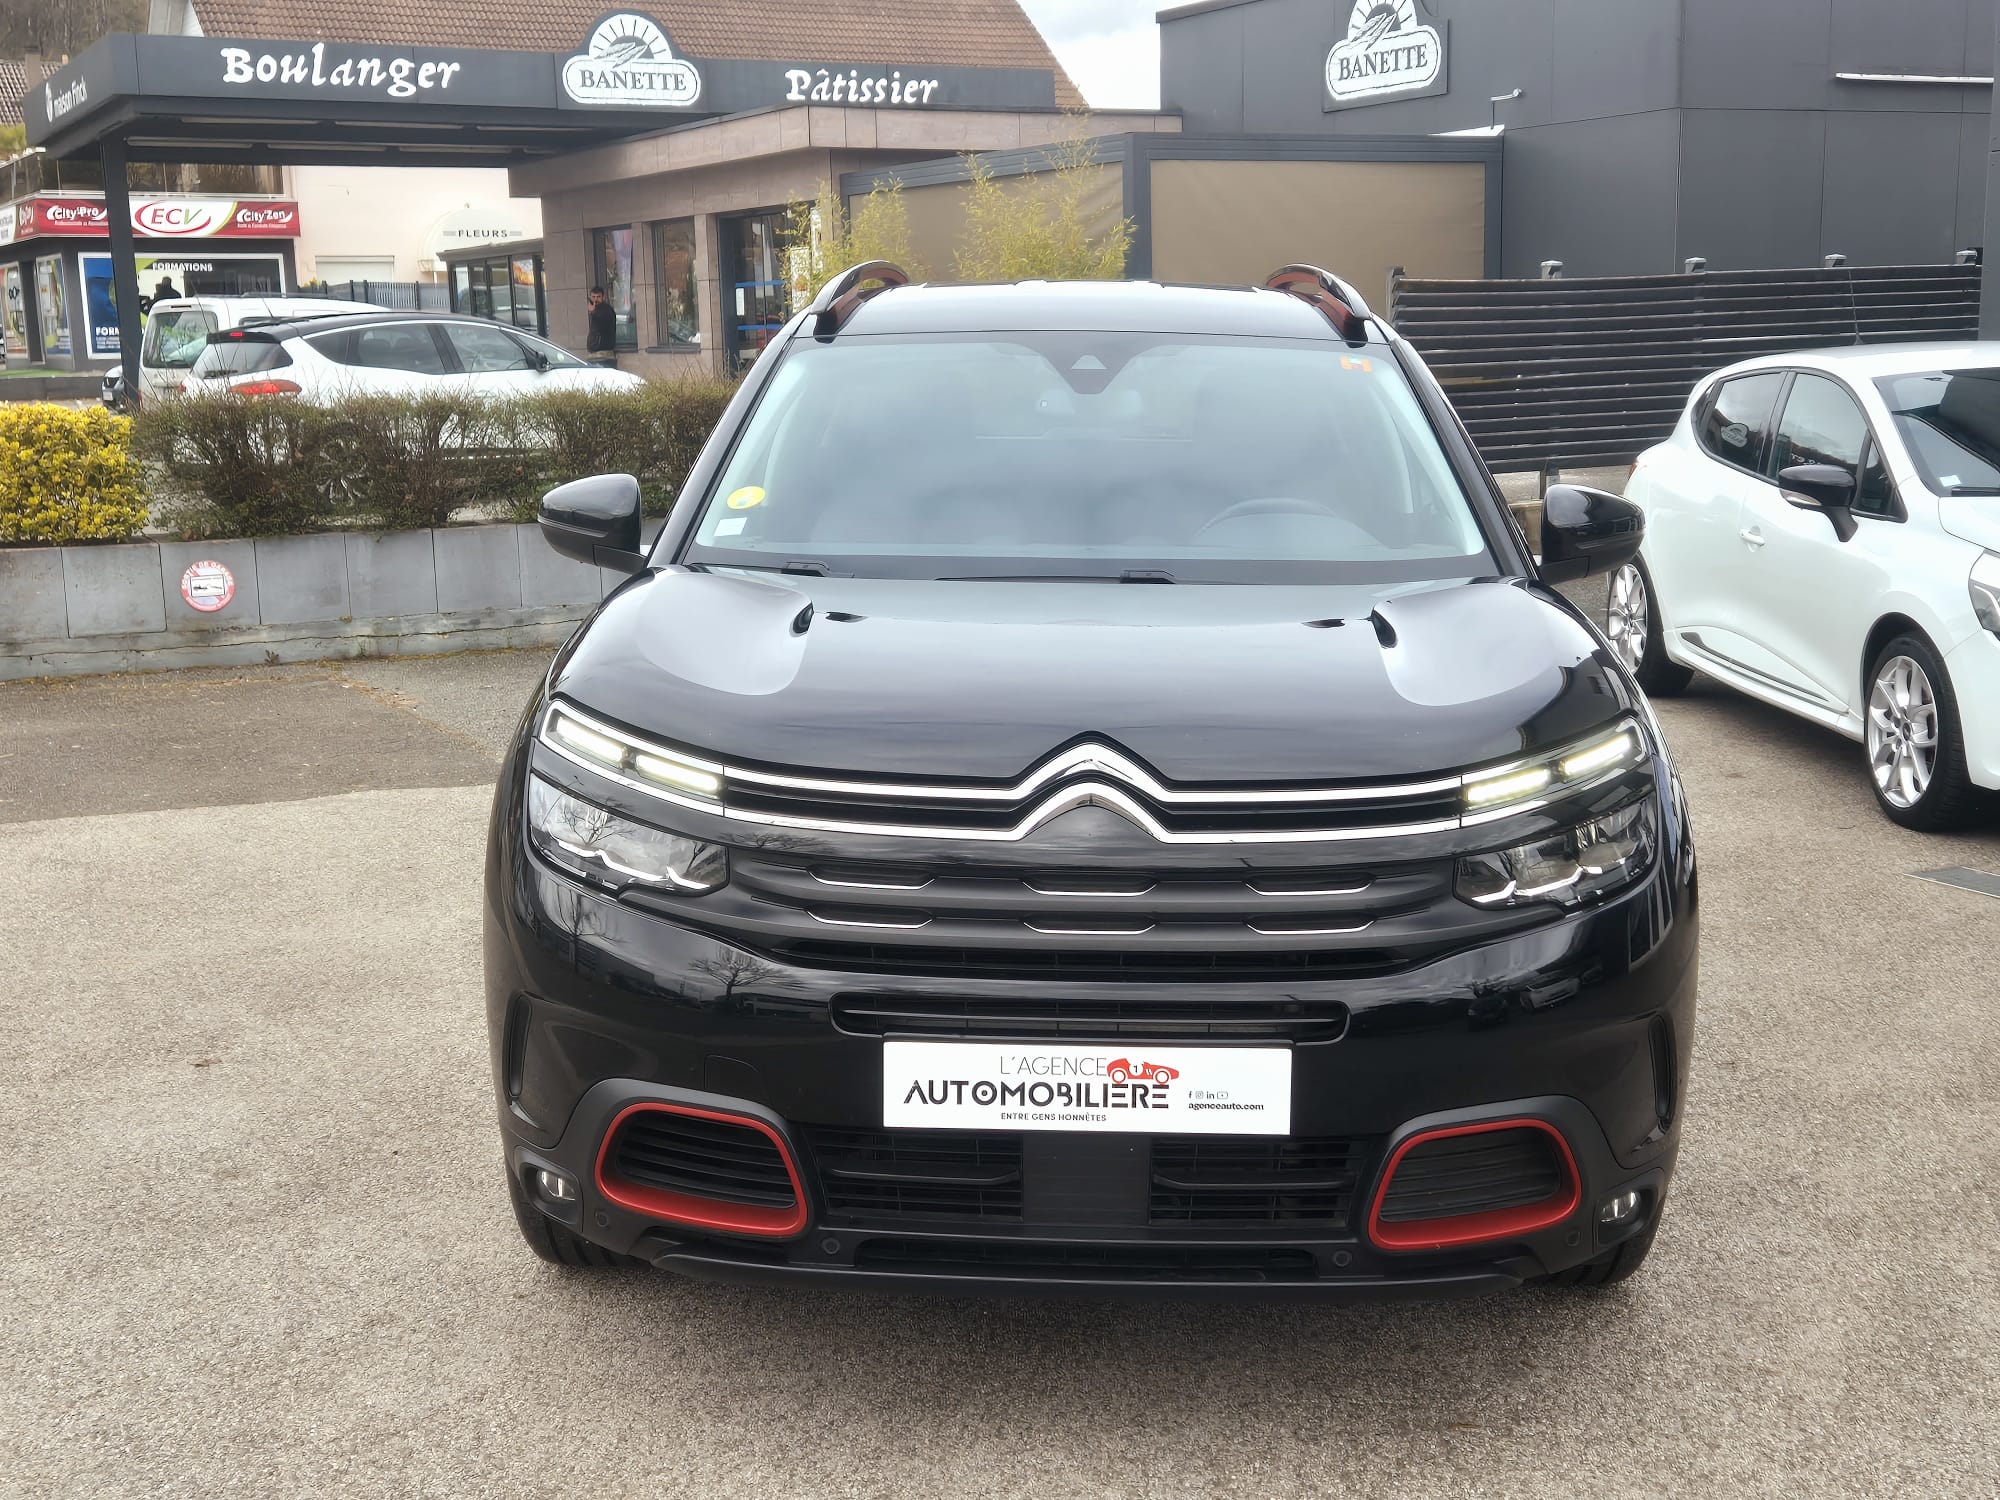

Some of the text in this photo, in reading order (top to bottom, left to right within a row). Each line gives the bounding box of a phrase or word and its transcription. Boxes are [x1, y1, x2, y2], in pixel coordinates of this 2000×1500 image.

[220, 42, 460, 97] Boulanger
[1338, 44, 1429, 81] BANETTE
[579, 69, 687, 92] BANETTE
[784, 68, 938, 104] Pâtissier
[151, 208, 203, 225] ECV
[458, 229, 508, 238] FLEURS
[152, 262, 213, 272] FORMATIONS
[1000, 1055, 1107, 1077] L'AGENCE
[1188, 1101, 1265, 1112] agenceauto.com
[1001, 1112, 1029, 1121] ENTRE
[1031, 1113, 1056, 1121] GENS
